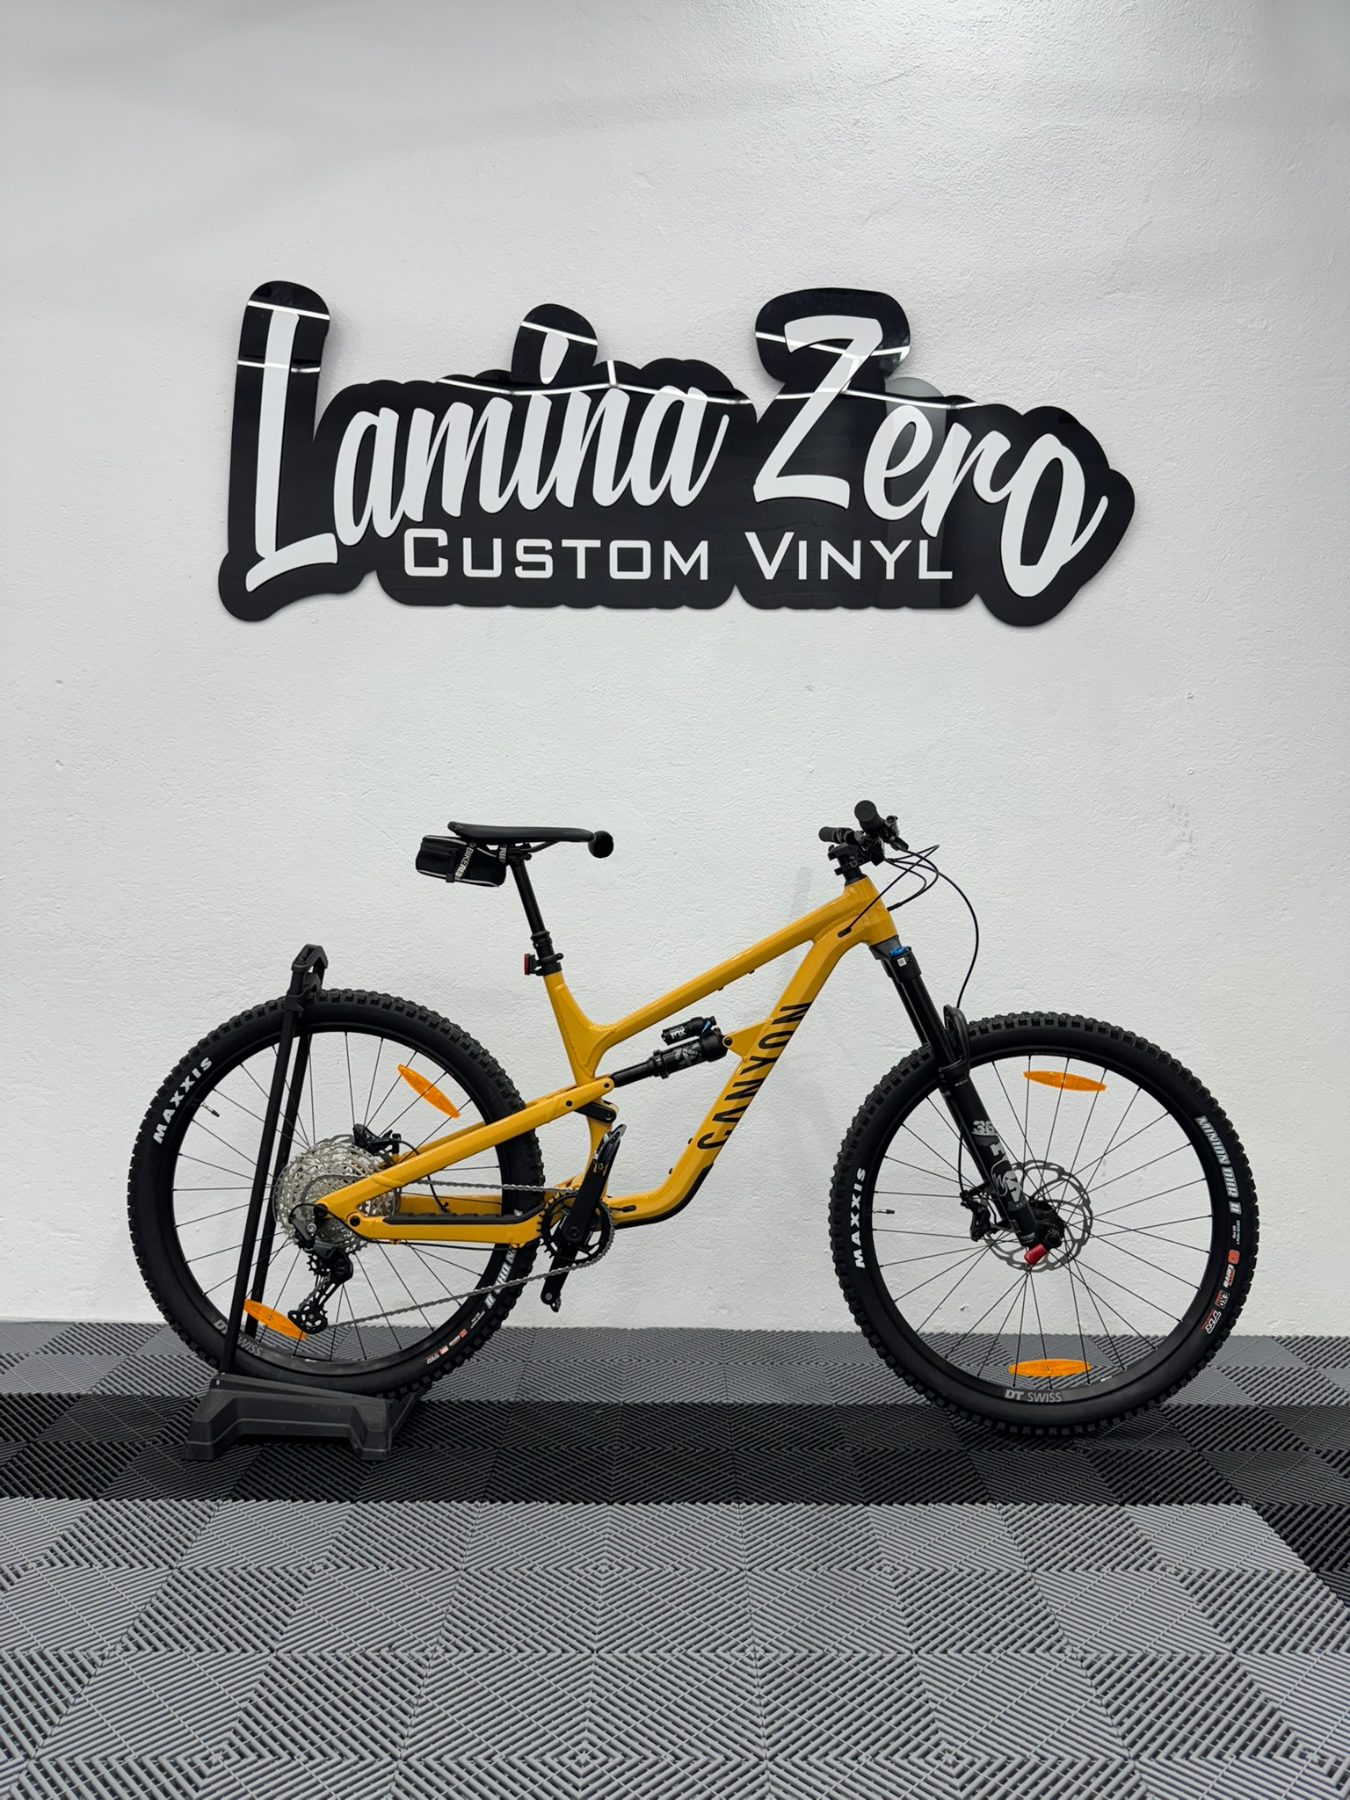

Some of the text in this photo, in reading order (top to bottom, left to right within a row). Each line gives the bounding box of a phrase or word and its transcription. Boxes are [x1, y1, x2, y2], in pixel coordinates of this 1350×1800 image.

[246, 309, 1109, 598] Lamina Zero
[403, 528, 953, 581] CUSTOM VINYL
[153, 1057, 212, 1144] MAXXIS
[696, 1001, 814, 1150] CANYON
[850, 1167, 866, 1268] MAXXIS
[238, 1333, 263, 1357] WISS
[1005, 1389, 1062, 1403] DT SWISS
